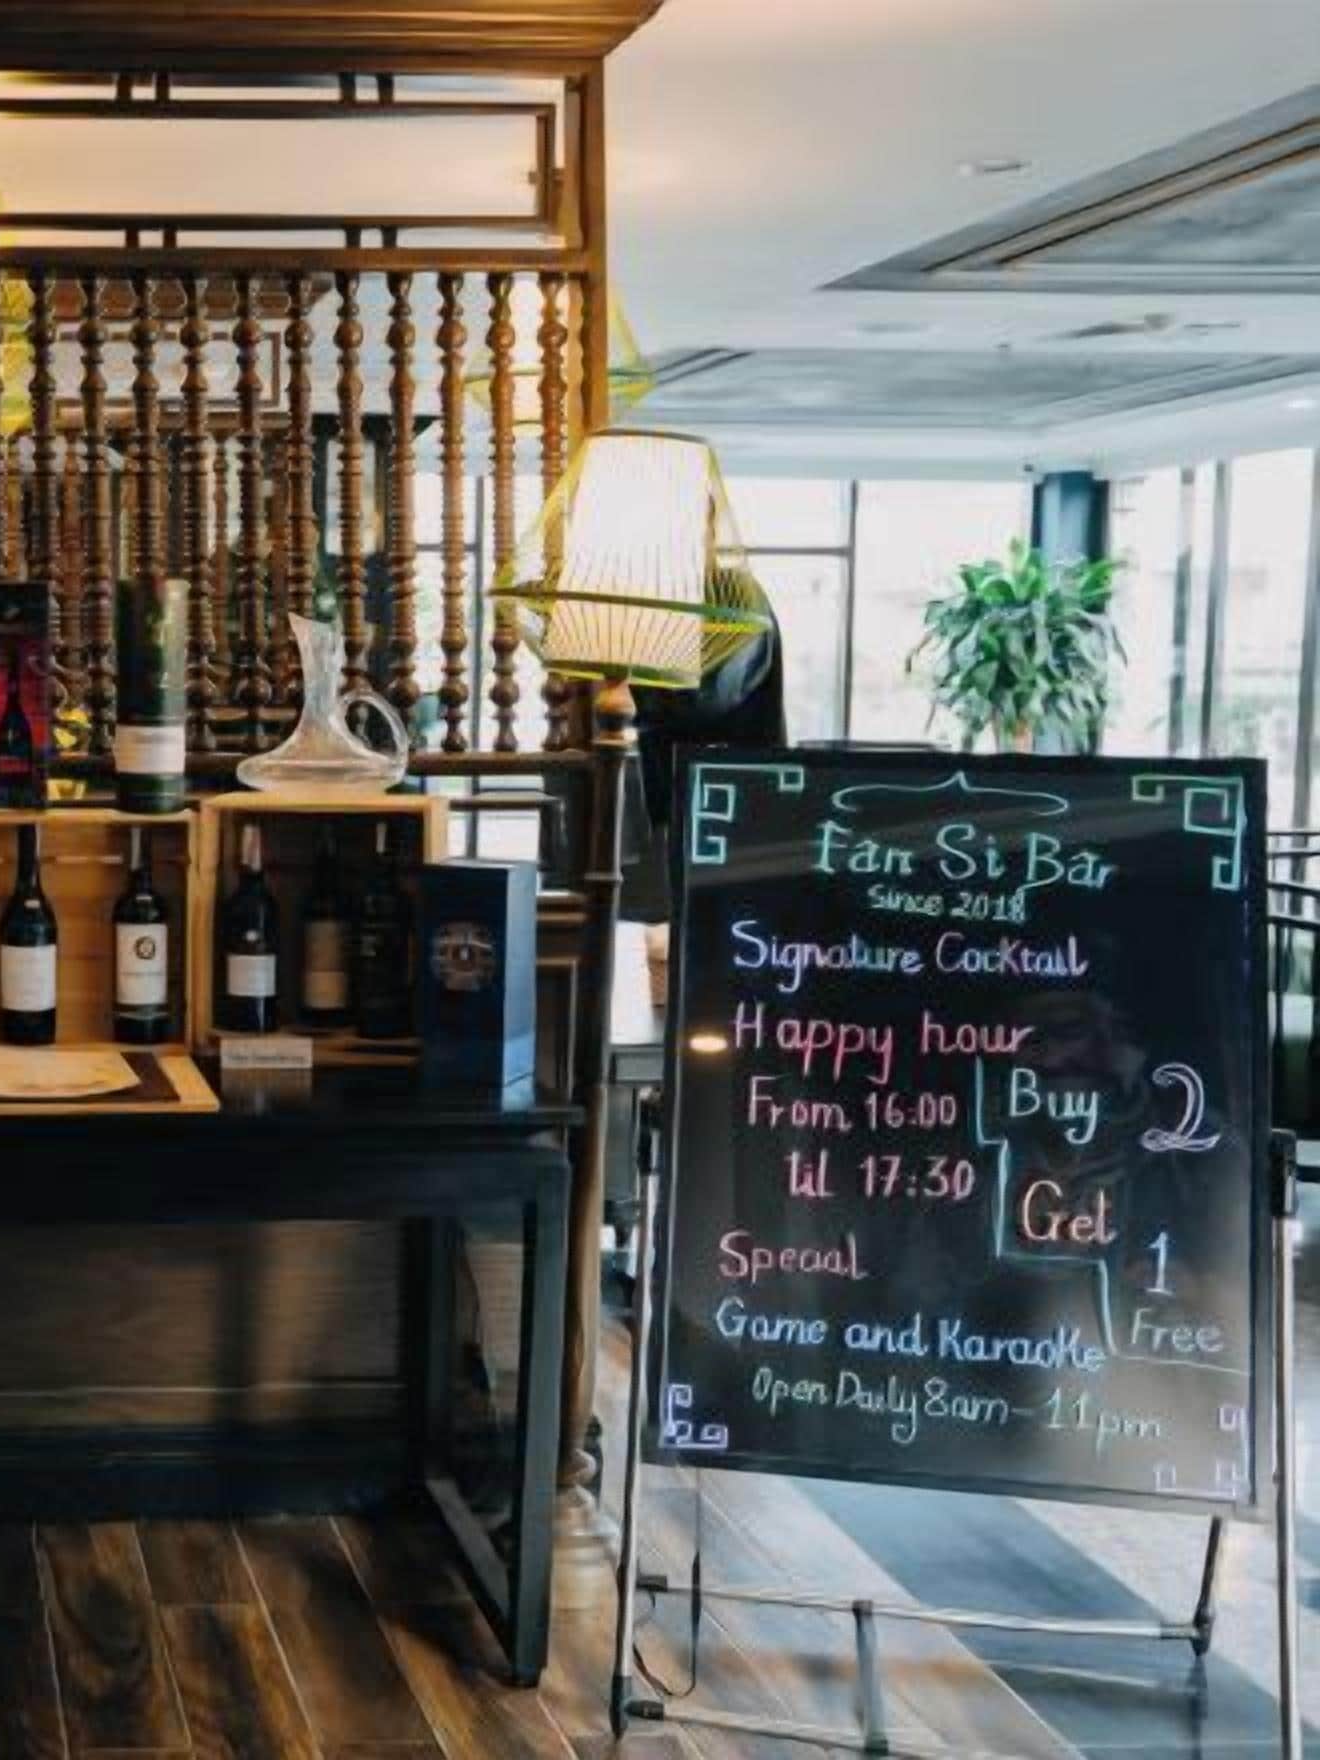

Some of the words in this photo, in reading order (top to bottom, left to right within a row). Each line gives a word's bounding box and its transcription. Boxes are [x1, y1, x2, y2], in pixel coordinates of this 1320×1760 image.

[936, 823, 1006, 880] Si
[1022, 831, 1118, 890] Bar
[731, 919, 926, 993] Signature
[734, 1001, 894, 1085] Happy
[920, 1010, 1037, 1056] hour
[747, 1075, 854, 1133] From
[864, 1091, 958, 1131] 16:00
[1008, 1067, 1100, 1145] Buy
[1139, 1062, 1222, 1152] 2
[859, 1154, 977, 1200] 17:30
[1021, 1179, 1118, 1245] Get
[718, 1229, 870, 1285] Special
[1148, 1231, 1174, 1295] 1
[714, 1296, 828, 1346] Game
[843, 1311, 928, 1358] and
[1131, 1307, 1225, 1353] Free
[751, 1367, 828, 1418] Open
[834, 1370, 918, 1444] Daily
